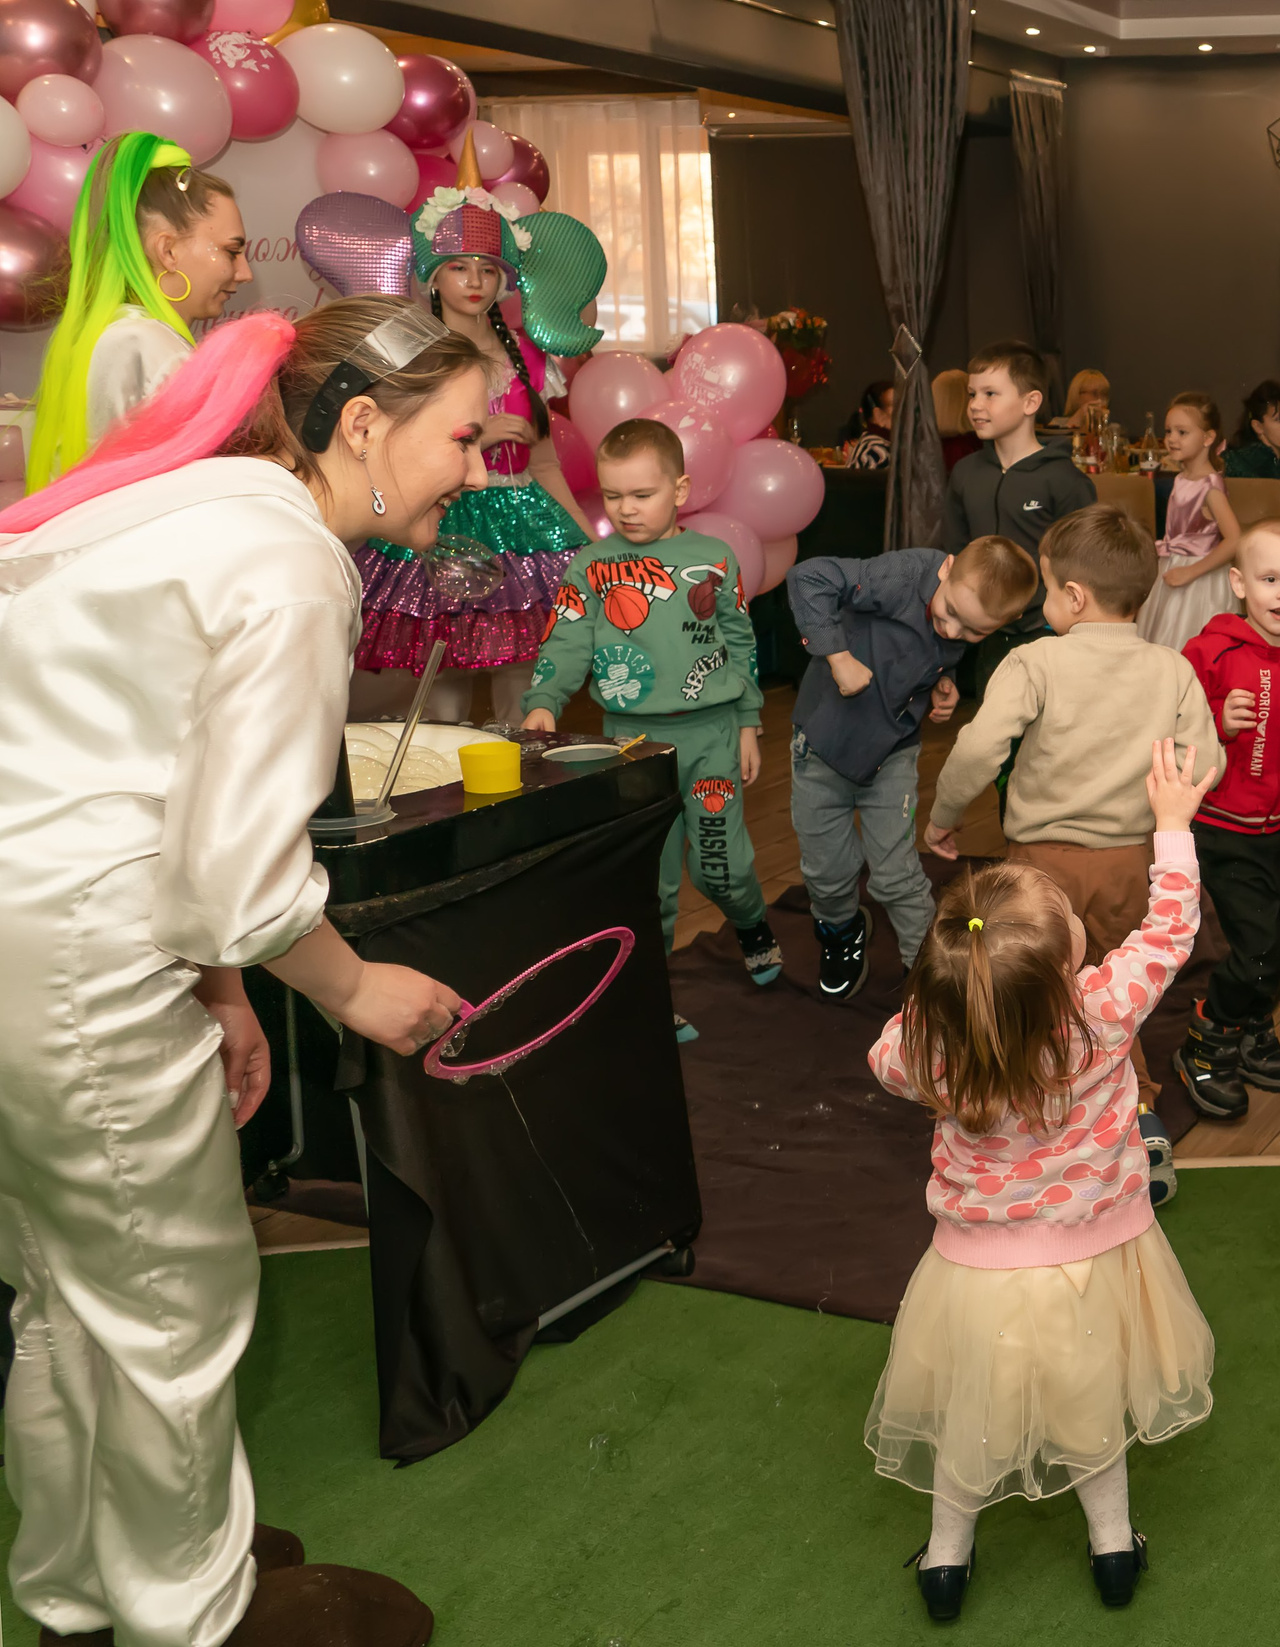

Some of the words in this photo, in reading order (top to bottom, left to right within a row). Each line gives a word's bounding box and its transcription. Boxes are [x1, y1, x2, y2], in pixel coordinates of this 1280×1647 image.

[617, 552, 640, 561] YORK
[586, 556, 678, 602] KNICKS
[592, 645, 651, 674] CELTICS
[1257, 668, 1271, 719] EMPORIO
[1250, 736, 1267, 777] ARMANI
[691, 779, 736, 798] KNICKS
[698, 816, 732, 900] BASKETB
